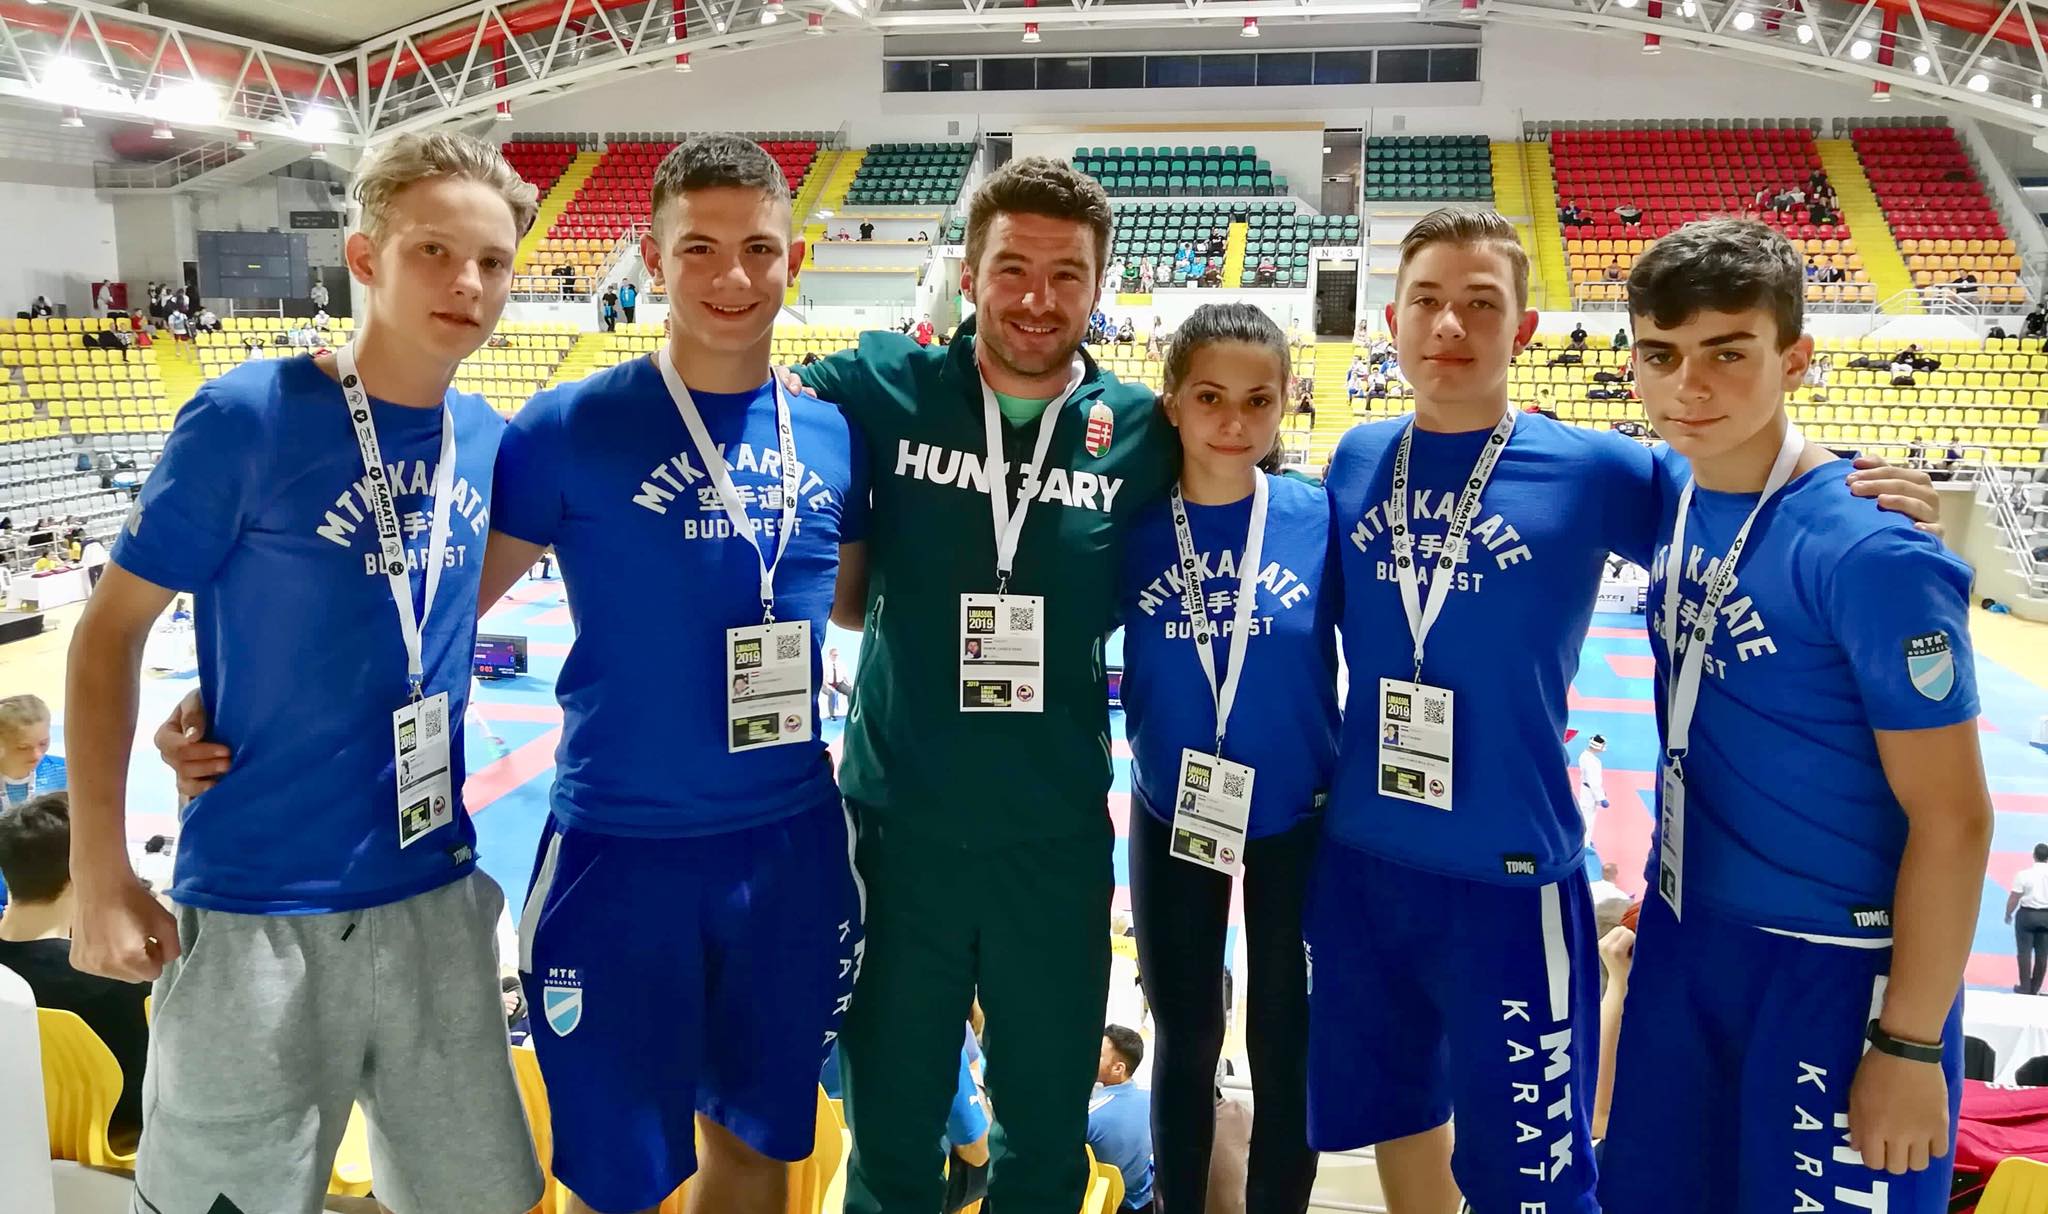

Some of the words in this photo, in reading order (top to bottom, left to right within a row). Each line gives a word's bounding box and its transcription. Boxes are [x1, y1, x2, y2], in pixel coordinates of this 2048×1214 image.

[632, 451, 706, 515] MTK
[894, 438, 1124, 513] HUNARY
[376, 481, 397, 537] KARATE1
[386, 460, 489, 536] KAATE
[1449, 491, 1477, 538] KARATE1
[364, 545, 466, 576] BUAPST
[1376, 561, 1484, 593] BUAST
[1137, 564, 1187, 617] MTK
[1195, 549, 1310, 610] KAATE
[1189, 570, 1203, 614] KARATE1
[968, 618, 994, 629] 2019
[1165, 616, 1274, 640] BUAPST
[1911, 634, 1943, 649] MTK
[735, 650, 761, 665] 2019
[1653, 611, 1727, 680] BUAST
[1387, 703, 1410, 717] 2019
[1187, 772, 1209, 787] 2019
[1505, 861, 1534, 875] TDMG
[1853, 910, 1889, 928] TDMG
[549, 968, 577, 979] MTK
[821, 919, 853, 1048] KARA
[1540, 1028, 1574, 1183] MTK
[1793, 1061, 1828, 1214] KARA
